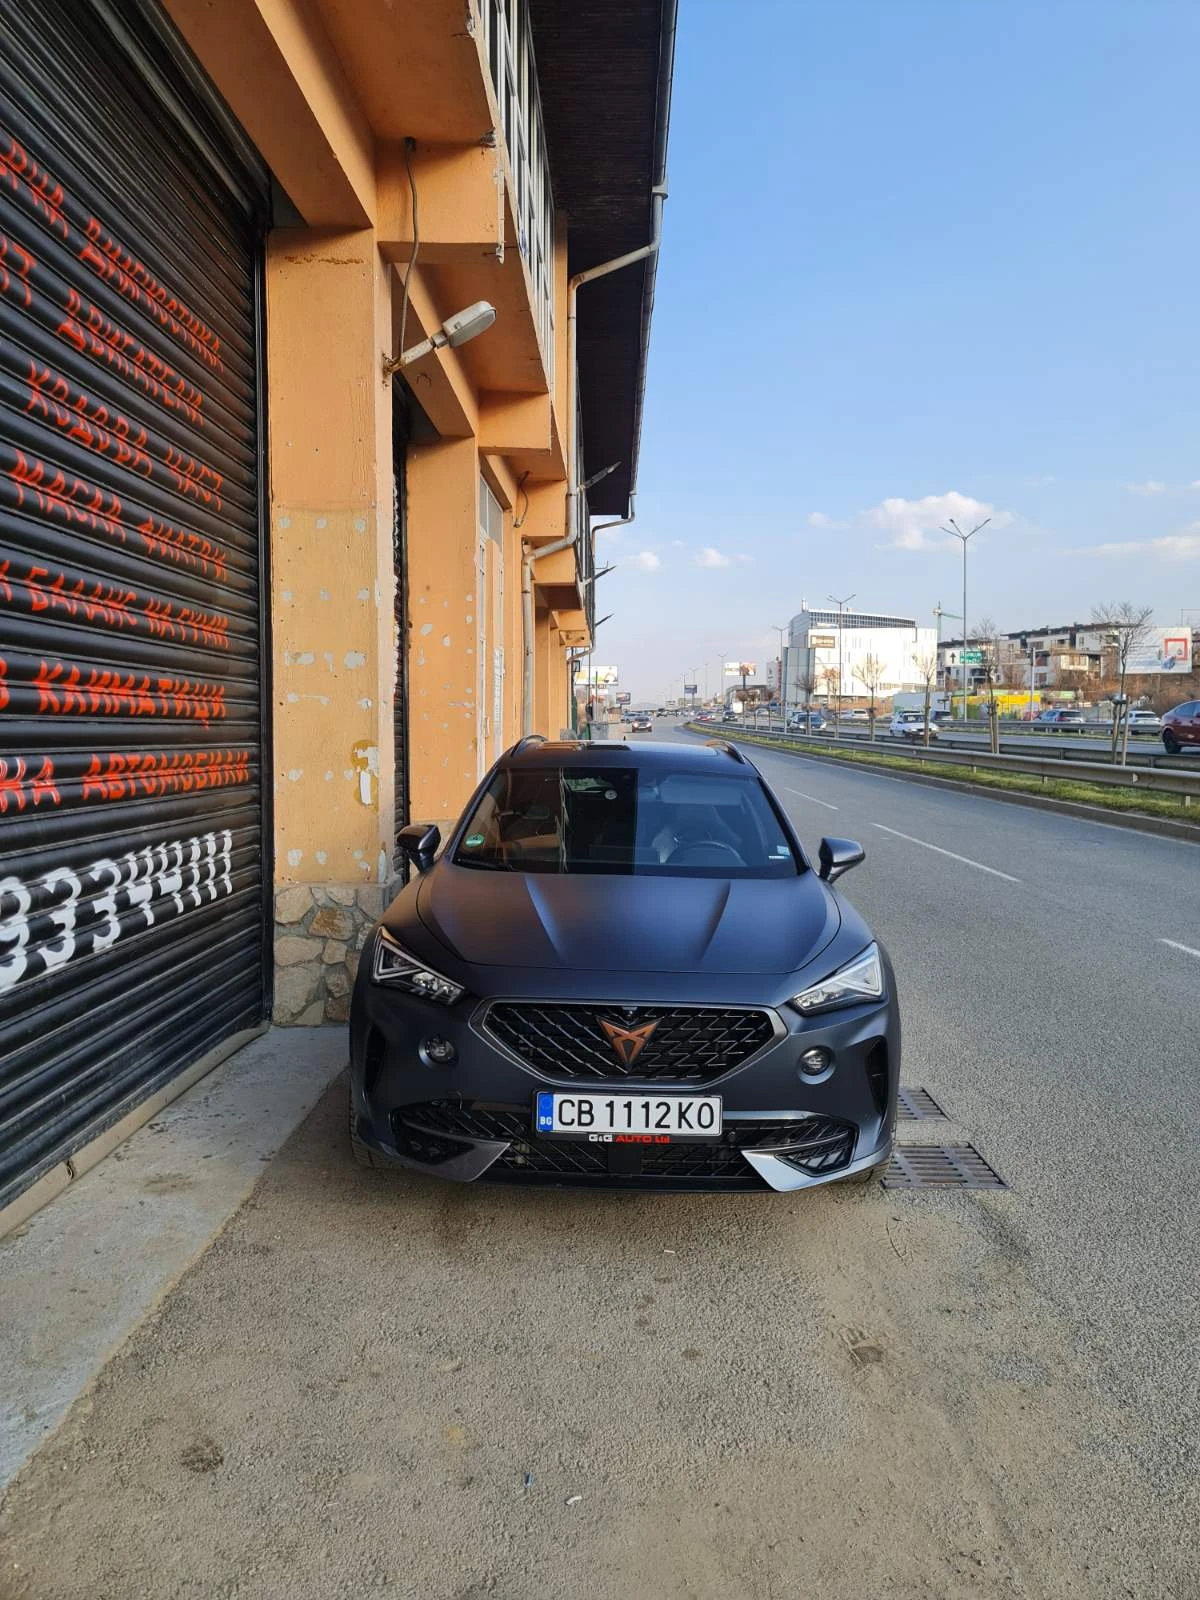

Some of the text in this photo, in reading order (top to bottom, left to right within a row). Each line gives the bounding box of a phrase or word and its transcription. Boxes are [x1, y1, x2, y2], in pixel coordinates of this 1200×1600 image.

[80, 214, 224, 373] ДИАГНОСТИКА
[57, 287, 205, 426] ДВИГАТЕЛИ
[165, 447, 223, 512] ЧАСТ
[25, 566, 137, 627] БАЛАНС
[33, 660, 226, 730] КЛИМАТИЦИ
[83, 750, 249, 800] АВТОМОБИЛИ
[539, 1116, 552, 1125] BG
[615, 1135, 652, 1144] AUTO
